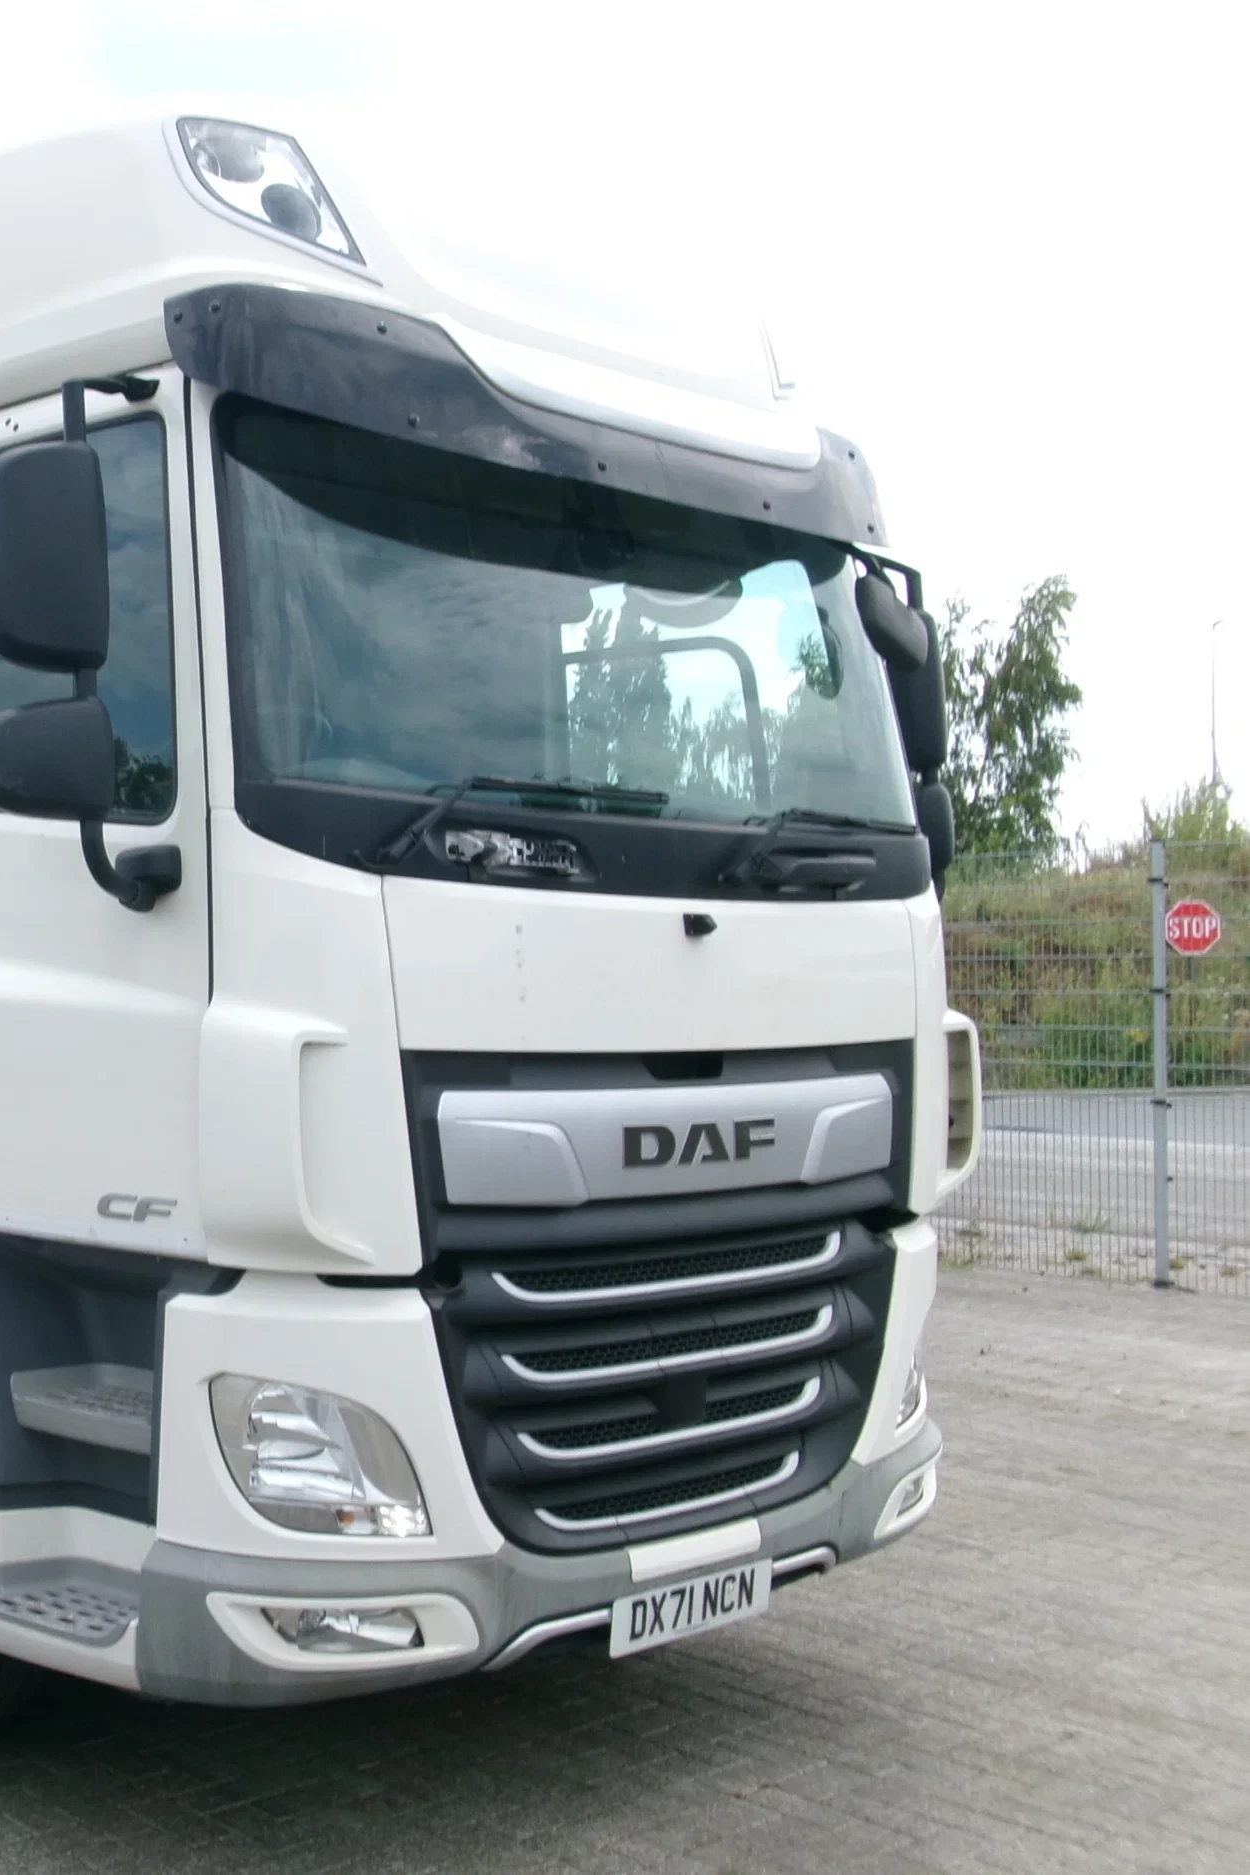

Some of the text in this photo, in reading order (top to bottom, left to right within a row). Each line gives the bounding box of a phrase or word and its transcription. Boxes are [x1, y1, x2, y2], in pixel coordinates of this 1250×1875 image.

[1169, 916, 1216, 939] STOP
[623, 1115, 775, 1168] DAF
[96, 1193, 178, 1223] CF
[629, 1568, 755, 1641] DX71 NCN
